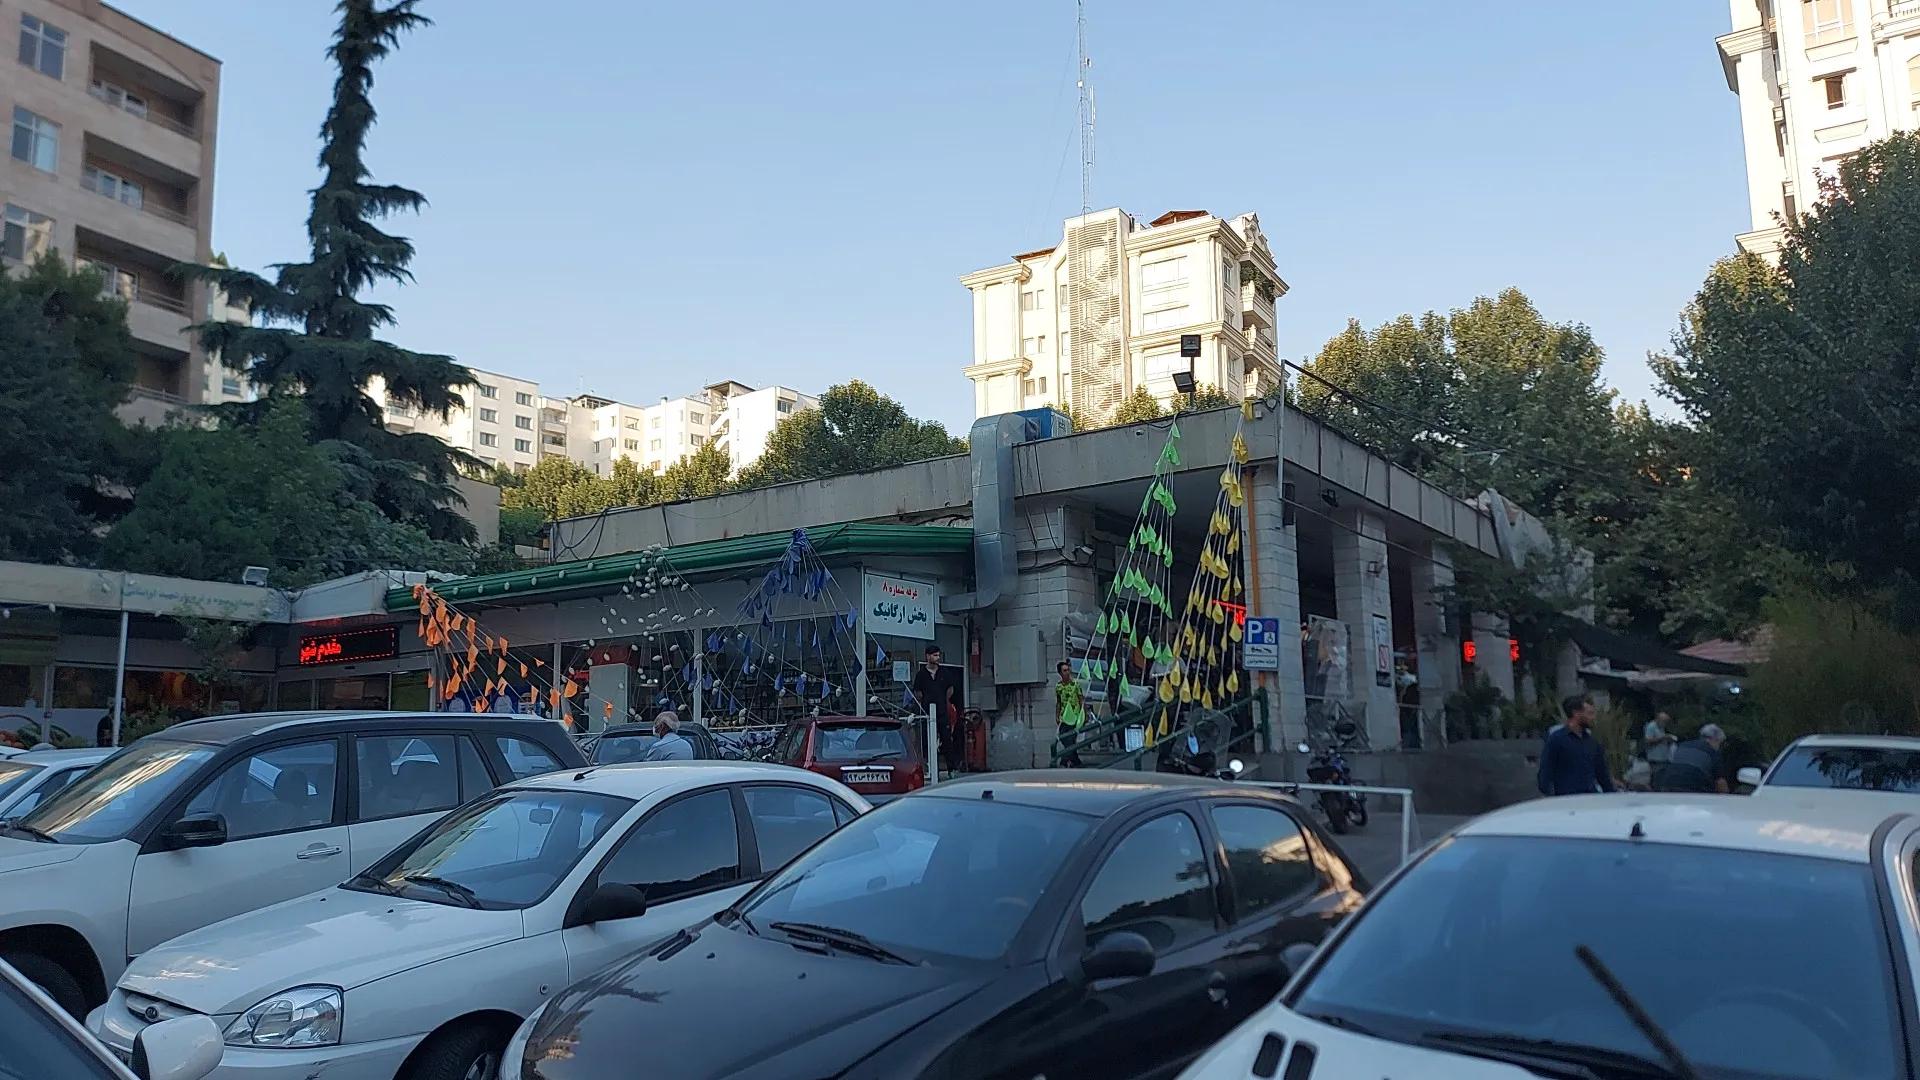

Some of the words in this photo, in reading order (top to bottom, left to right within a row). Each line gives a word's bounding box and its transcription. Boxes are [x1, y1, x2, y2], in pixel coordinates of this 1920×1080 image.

[889, 584, 904, 597] شماره
[906, 586, 918, 599] غرفه
[873, 602, 906, 624] ارگانیک
[907, 607, 927, 626] بخش
[1248, 620, 1263, 643] P
